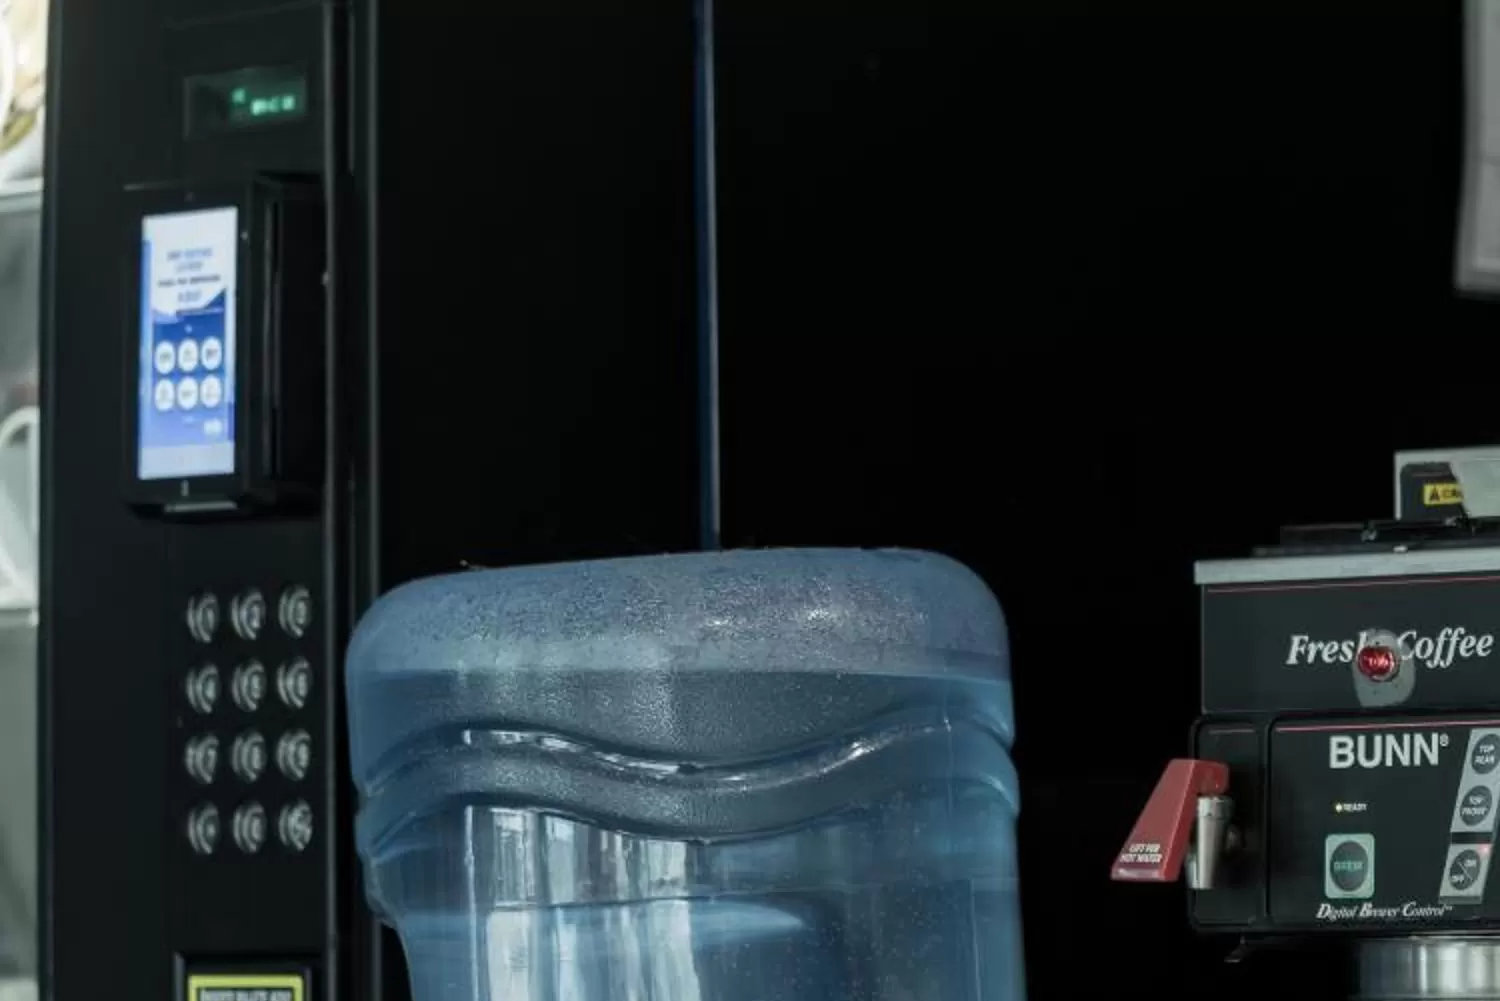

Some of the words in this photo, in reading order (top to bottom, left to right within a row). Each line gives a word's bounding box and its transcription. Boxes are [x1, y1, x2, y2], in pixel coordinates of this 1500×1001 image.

[1397, 627, 1494, 669] Coffee
[1316, 903, 1359, 922] Digital
[1359, 902, 1400, 918] Brewer
